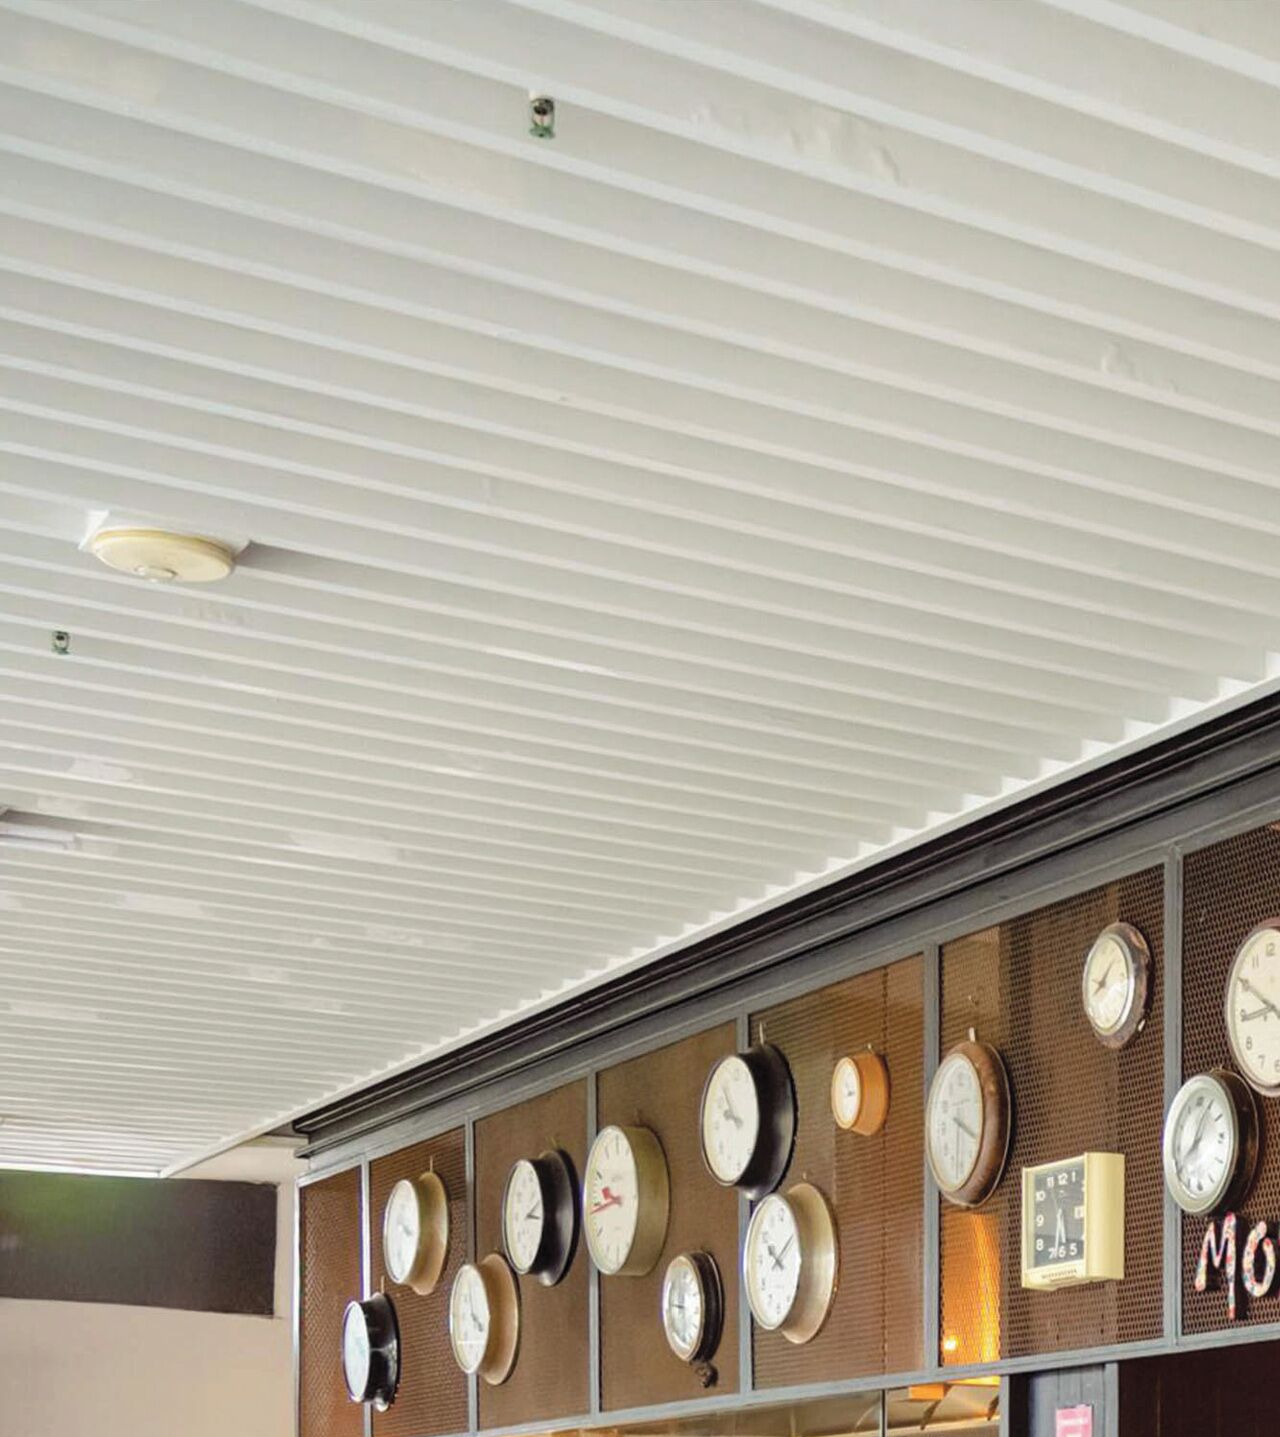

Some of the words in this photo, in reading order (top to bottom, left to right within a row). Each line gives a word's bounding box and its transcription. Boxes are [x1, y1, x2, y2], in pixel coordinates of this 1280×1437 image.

[1265, 942, 1275, 957] 12
[1252, 956, 1259, 968] 11
[1245, 1036, 1253, 1050] 8
[1058, 1173, 1069, 1185] 12
[1071, 1171, 1076, 1183] 1
[1036, 1191, 1046, 1202] 10
[1036, 1214, 1044, 1227] 9
[1036, 1239, 1044, 1251] 8
[1069, 1243, 1077, 1256] 5
[1058, 1246, 1066, 1258] 6
